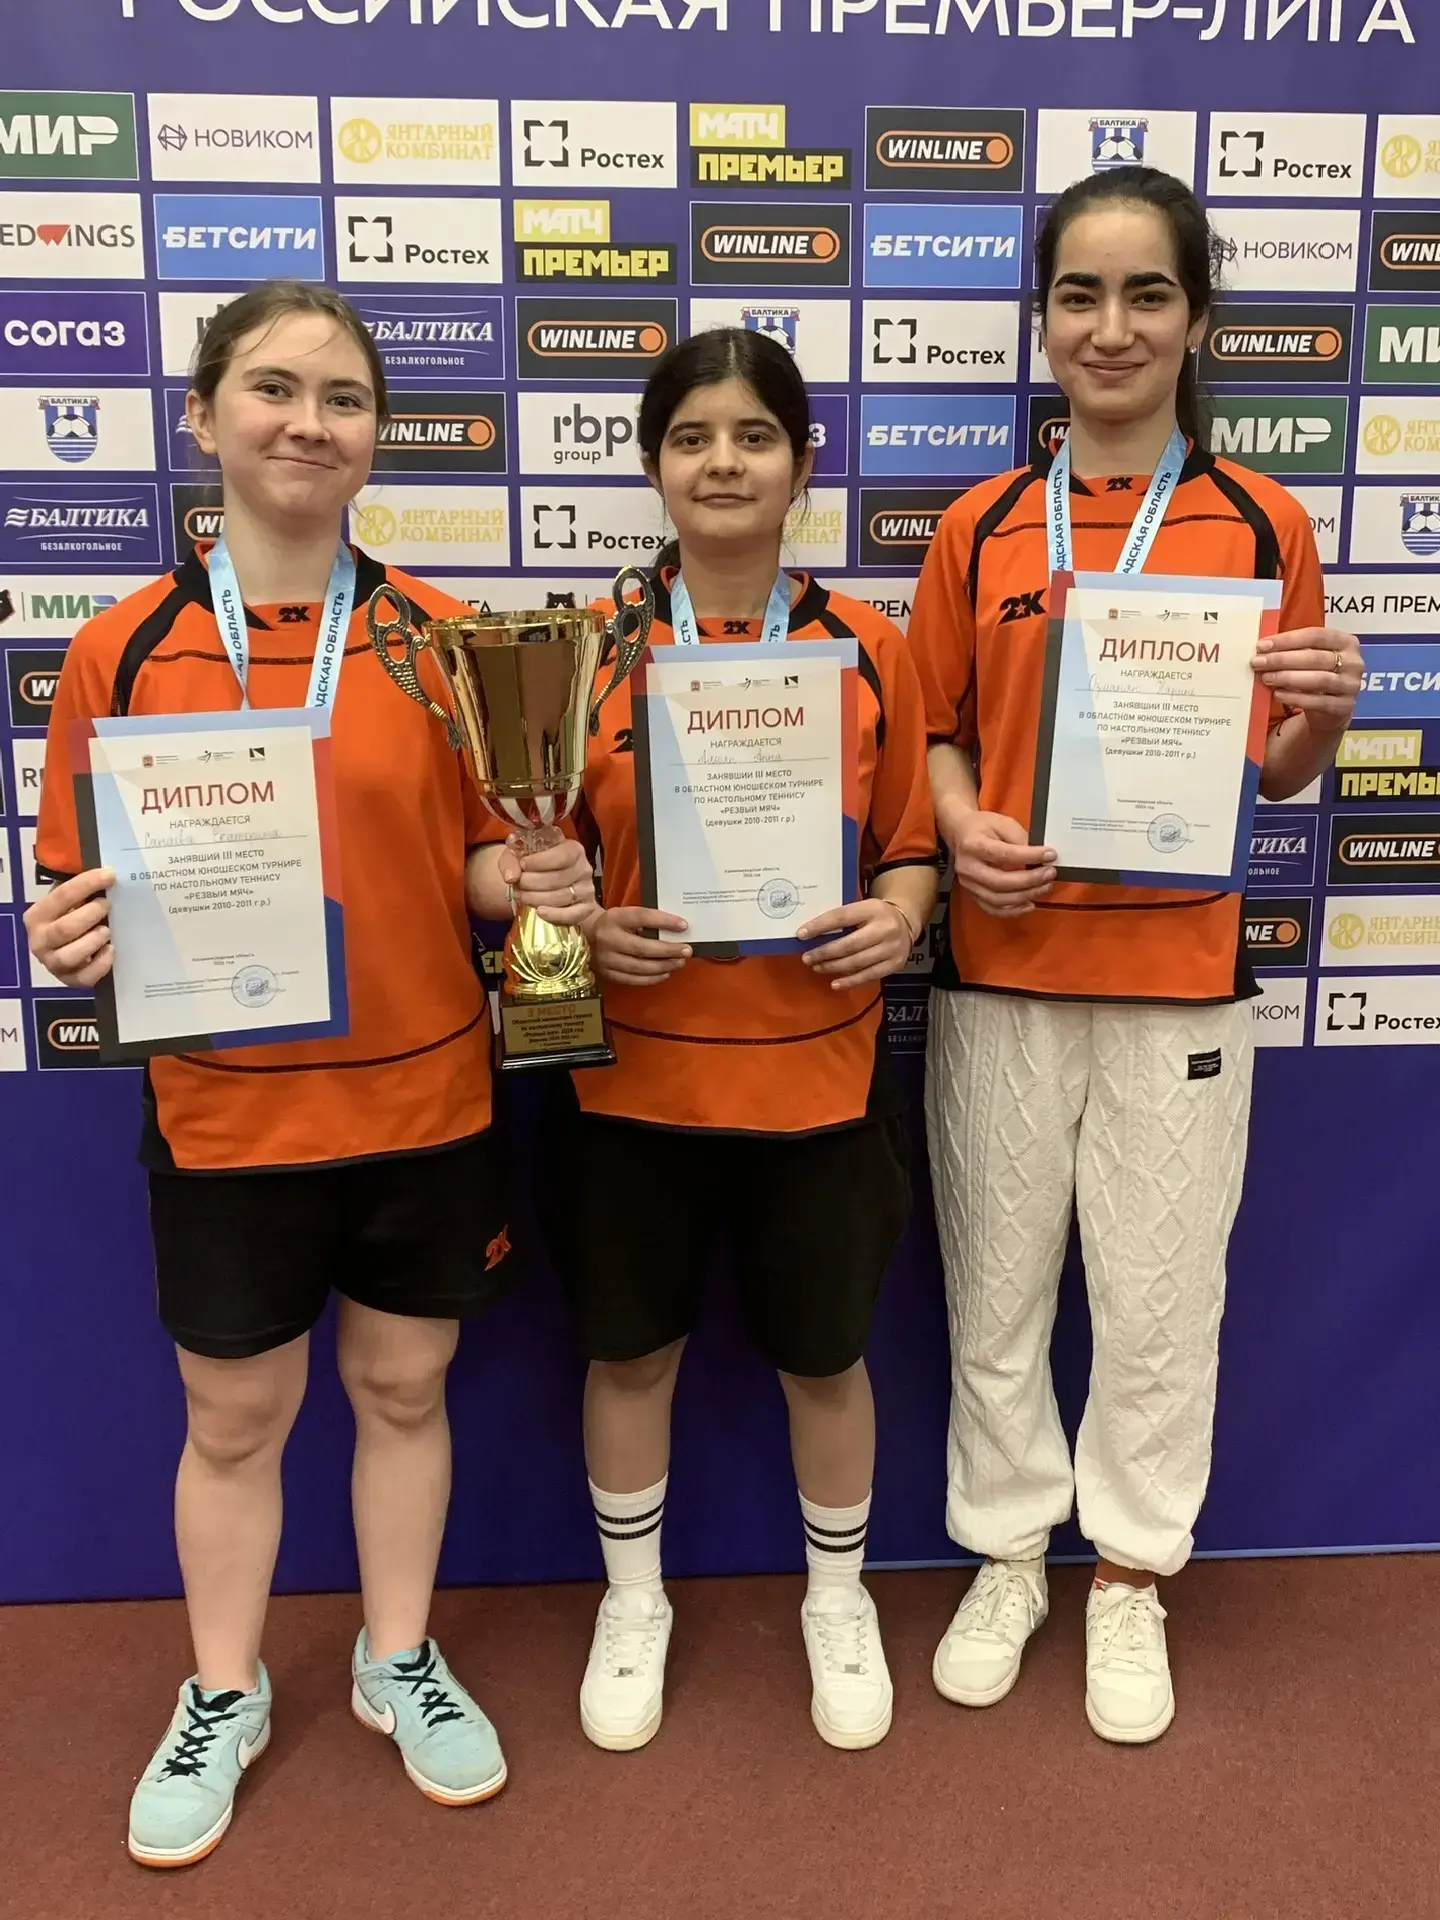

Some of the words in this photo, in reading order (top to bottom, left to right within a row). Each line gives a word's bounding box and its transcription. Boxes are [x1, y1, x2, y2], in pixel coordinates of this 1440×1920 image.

[385, 123, 494, 142] ЯНТАРНЫЙ
[698, 111, 778, 140] МАТЧ
[1099, 118, 1137, 128] БАЛТИКА
[0, 115, 119, 156] МИР
[194, 129, 313, 149] НОВИКОМ
[385, 142, 494, 161] КОМБИНАТ
[580, 147, 664, 169] Ростех
[888, 139, 983, 161] WINLINE
[698, 153, 844, 183] ПРЕМЬЕР
[1273, 158, 1352, 179] Ростех
[522, 207, 603, 236] МАТЧ
[162, 226, 316, 250] БЕТСИТИ
[713, 234, 808, 255] WINLINE
[870, 235, 1015, 259] БЕТСИТИ
[405, 244, 490, 265] Ростех
[1244, 241, 1352, 259] НОВИКОМ
[523, 249, 669, 277] ПРЕМЬЕР
[751, 308, 789, 316] БАЛТИКА
[374, 321, 494, 342] БАЛТИКА
[540, 329, 636, 349] WINLINE
[1221, 334, 1312, 353] WINLINE
[385, 355, 465, 366] БЕЗАЛКОГОЛЬНОЕ
[927, 345, 1006, 365] Ростех
[50, 397, 89, 405] БАЛТИКА
[867, 425, 1009, 446] БЕТСИТИ
[1210, 417, 1332, 453] МИР
[554, 449, 601, 464] group
[1054, 467, 1064, 521] ОБЛАСТЬ
[1145, 471, 1171, 524] ОБЛАСТЬ
[28, 507, 150, 528] БАЛТИКА
[400, 508, 504, 525] ЯНТАРНЫЙ
[400, 526, 504, 543] КОМБИНАТ
[588, 531, 667, 549] Ростех
[41, 542, 122, 551] БЕЗАЛКОГОЛЬНОЕ
[221, 589, 243, 650] ОБЛАСТЬ
[325, 592, 345, 654] ОБЛАСТЬ
[1099, 638, 1220, 663] ДИПЛОМ
[1120, 669, 1193, 681] НАГРАЖДАЕТСЯ
[1172, 704, 1199, 712] МЕСТО
[687, 706, 804, 734] ДИПЛОМ
[1079, 711, 1085, 719] В
[1086, 712, 1135, 721] ОБЛАСТНОМ
[1137, 715, 1192, 724] ЮНОШЕСКОМ
[1194, 717, 1232, 726] ТУРНИРЕ
[1096, 724, 1108, 732] ПО
[1110, 724, 1171, 735] НАСТОЛЬНОМУ
[1172, 727, 1211, 737] ТЕННИСУ
[710, 737, 782, 749] НАГРАЖДАЕТСЯ
[1105, 747, 1143, 757] (девушки
[1145, 749, 1180, 758] 2010-2011
[1344, 737, 1416, 760] МАТЧ
[766, 769, 792, 778] МЕСТО
[682, 783, 732, 793] ОБЛАСТНОМ
[733, 781, 787, 791] ЮНОШЕСКОМ
[788, 779, 824, 788] ТУРНИРЕ
[141, 781, 275, 814] ДИПЛОМ
[694, 796, 706, 804] ПО
[707, 794, 767, 804] НАСТОЛЬНОМУ
[768, 791, 805, 801] ТЕННИСУ
[170, 815, 251, 829] НАГРАЖДАЕТСЯ
[705, 818, 743, 827] (девушки
[744, 816, 779, 825] 2010-2011
[235, 849, 265, 859] МЕСТО
[1350, 841, 1436, 858] WINLINE
[130, 873, 137, 881] В
[139, 868, 196, 880] ОБЛАСТНОМ
[198, 863, 259, 875] ЮНОШЕСКОМ
[261, 859, 302, 870] ТУРНИРЕ
[153, 883, 167, 891] ПО
[169, 877, 238, 890] НАСТОЛЬНОМУ
[240, 873, 281, 884] ТЕННИСУ
[168, 905, 210, 915] (девушки
[212, 900, 252, 910] 2010-2011
